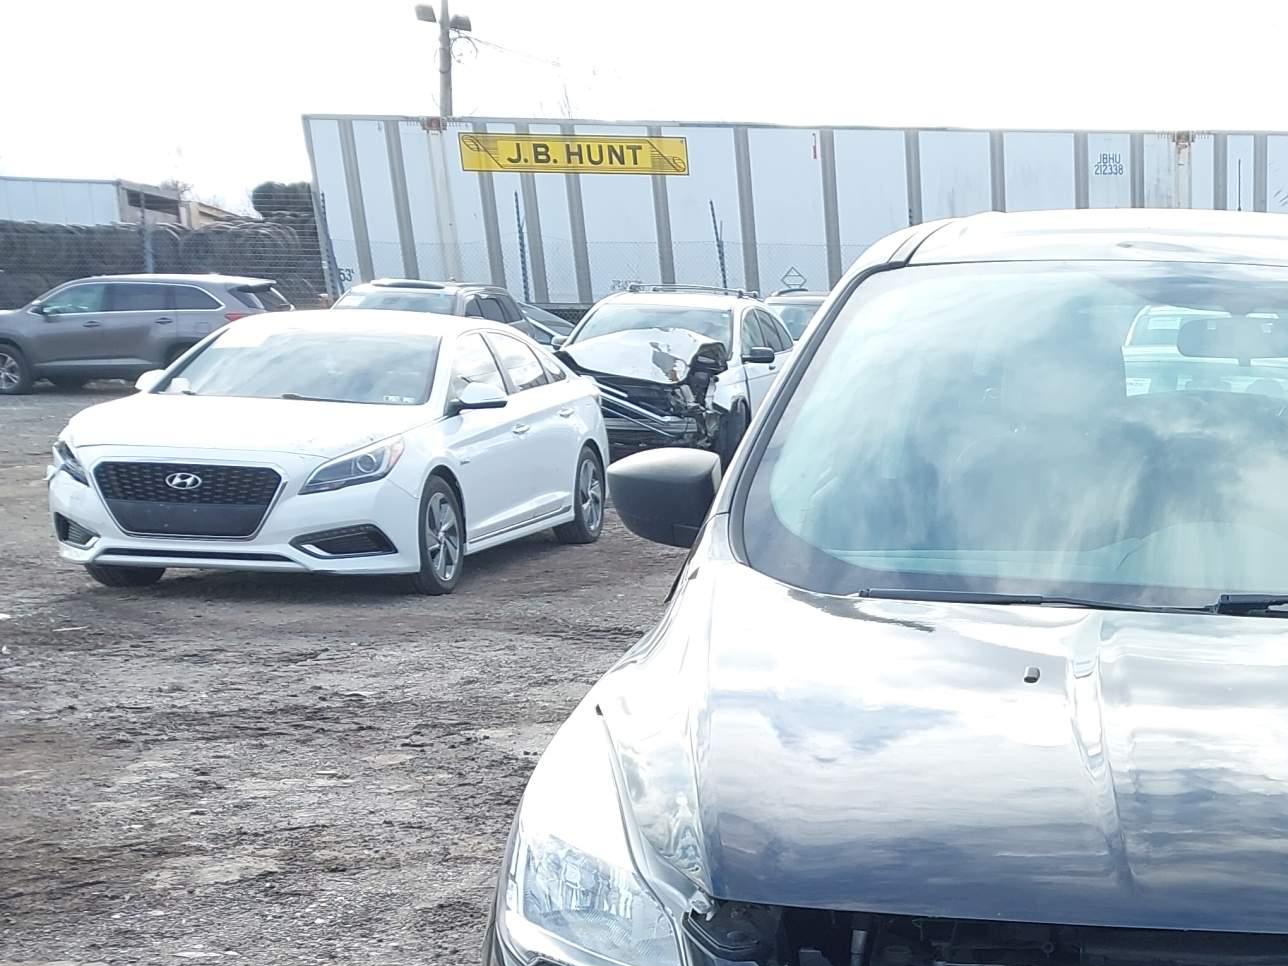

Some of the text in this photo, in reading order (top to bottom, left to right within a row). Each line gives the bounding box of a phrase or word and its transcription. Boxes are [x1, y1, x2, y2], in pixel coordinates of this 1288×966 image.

[506, 142, 643, 166] J.B. HUNT
[1096, 152, 1121, 164] JBHU
[1094, 164, 1124, 176] 212338
